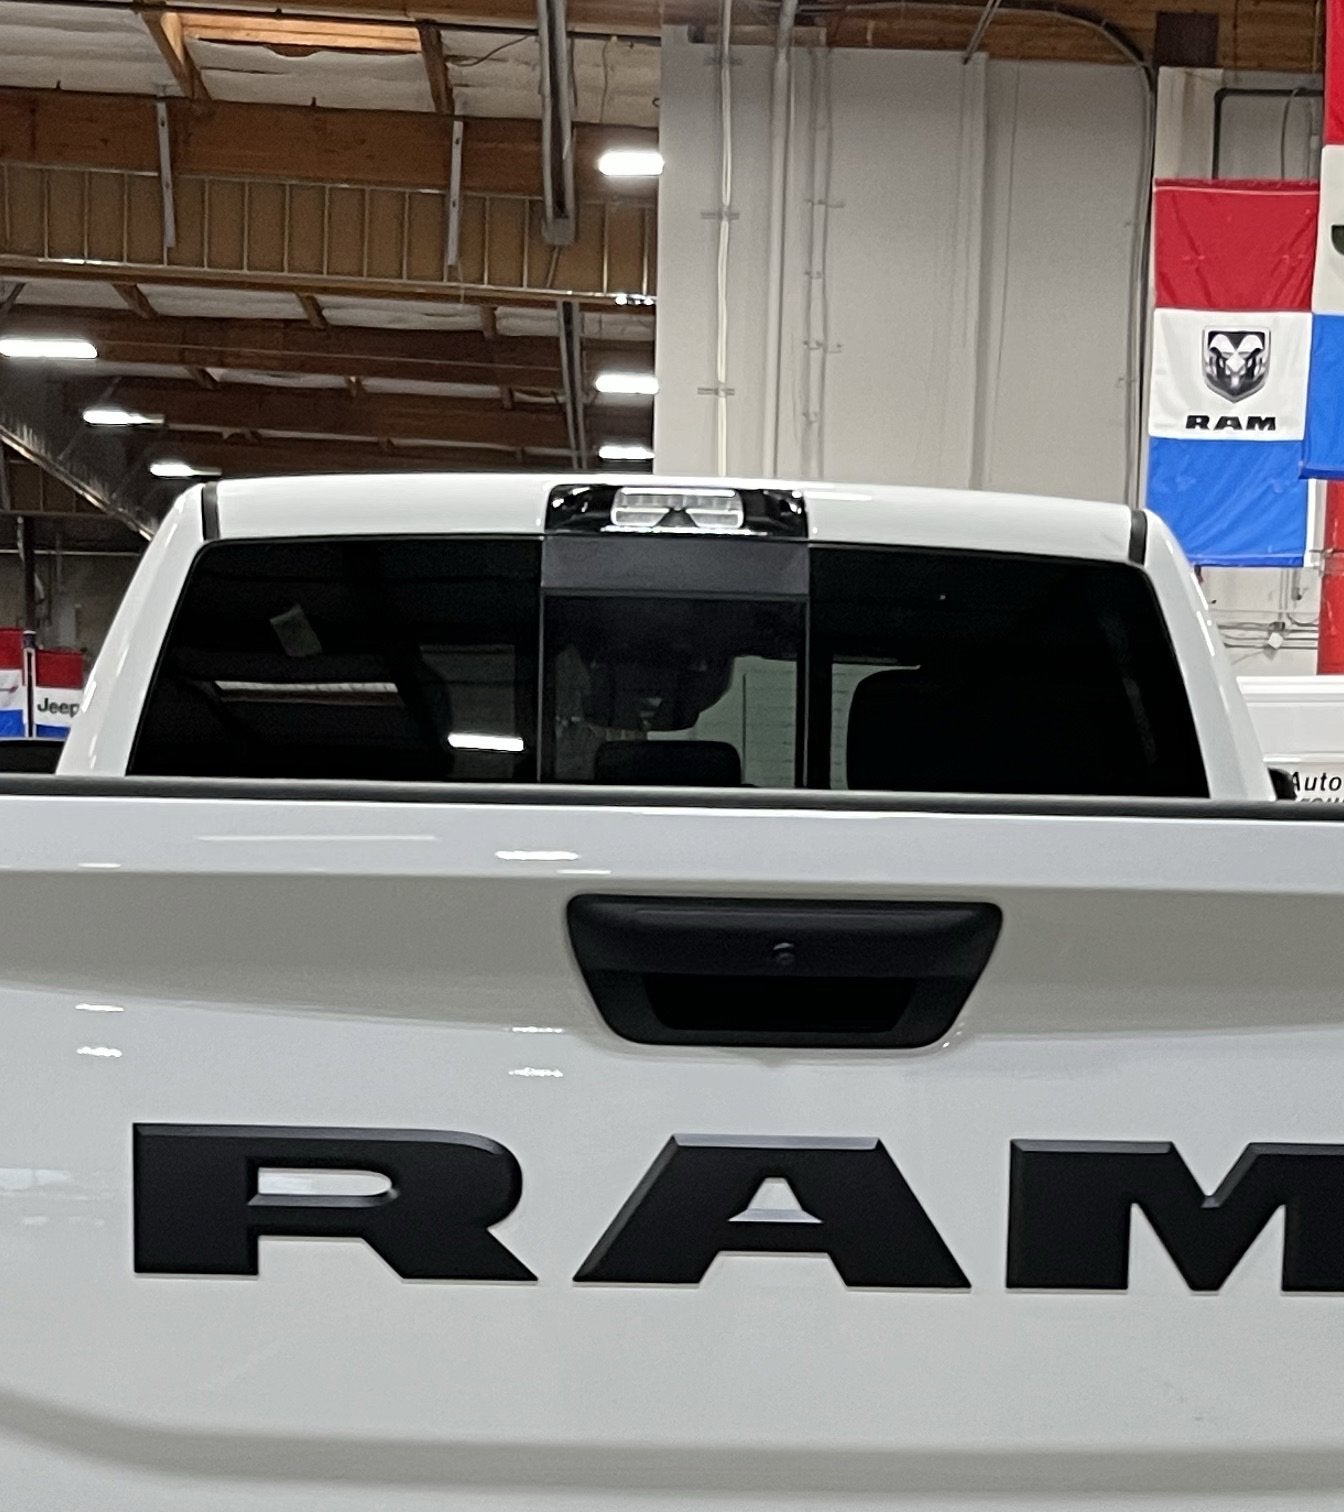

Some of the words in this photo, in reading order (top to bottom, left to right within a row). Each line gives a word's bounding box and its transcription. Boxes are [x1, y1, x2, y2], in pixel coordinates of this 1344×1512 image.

[1185, 414, 1277, 432] RAM
[37, 697, 80, 719] Jeep
[1291, 771, 1343, 793] Auto
